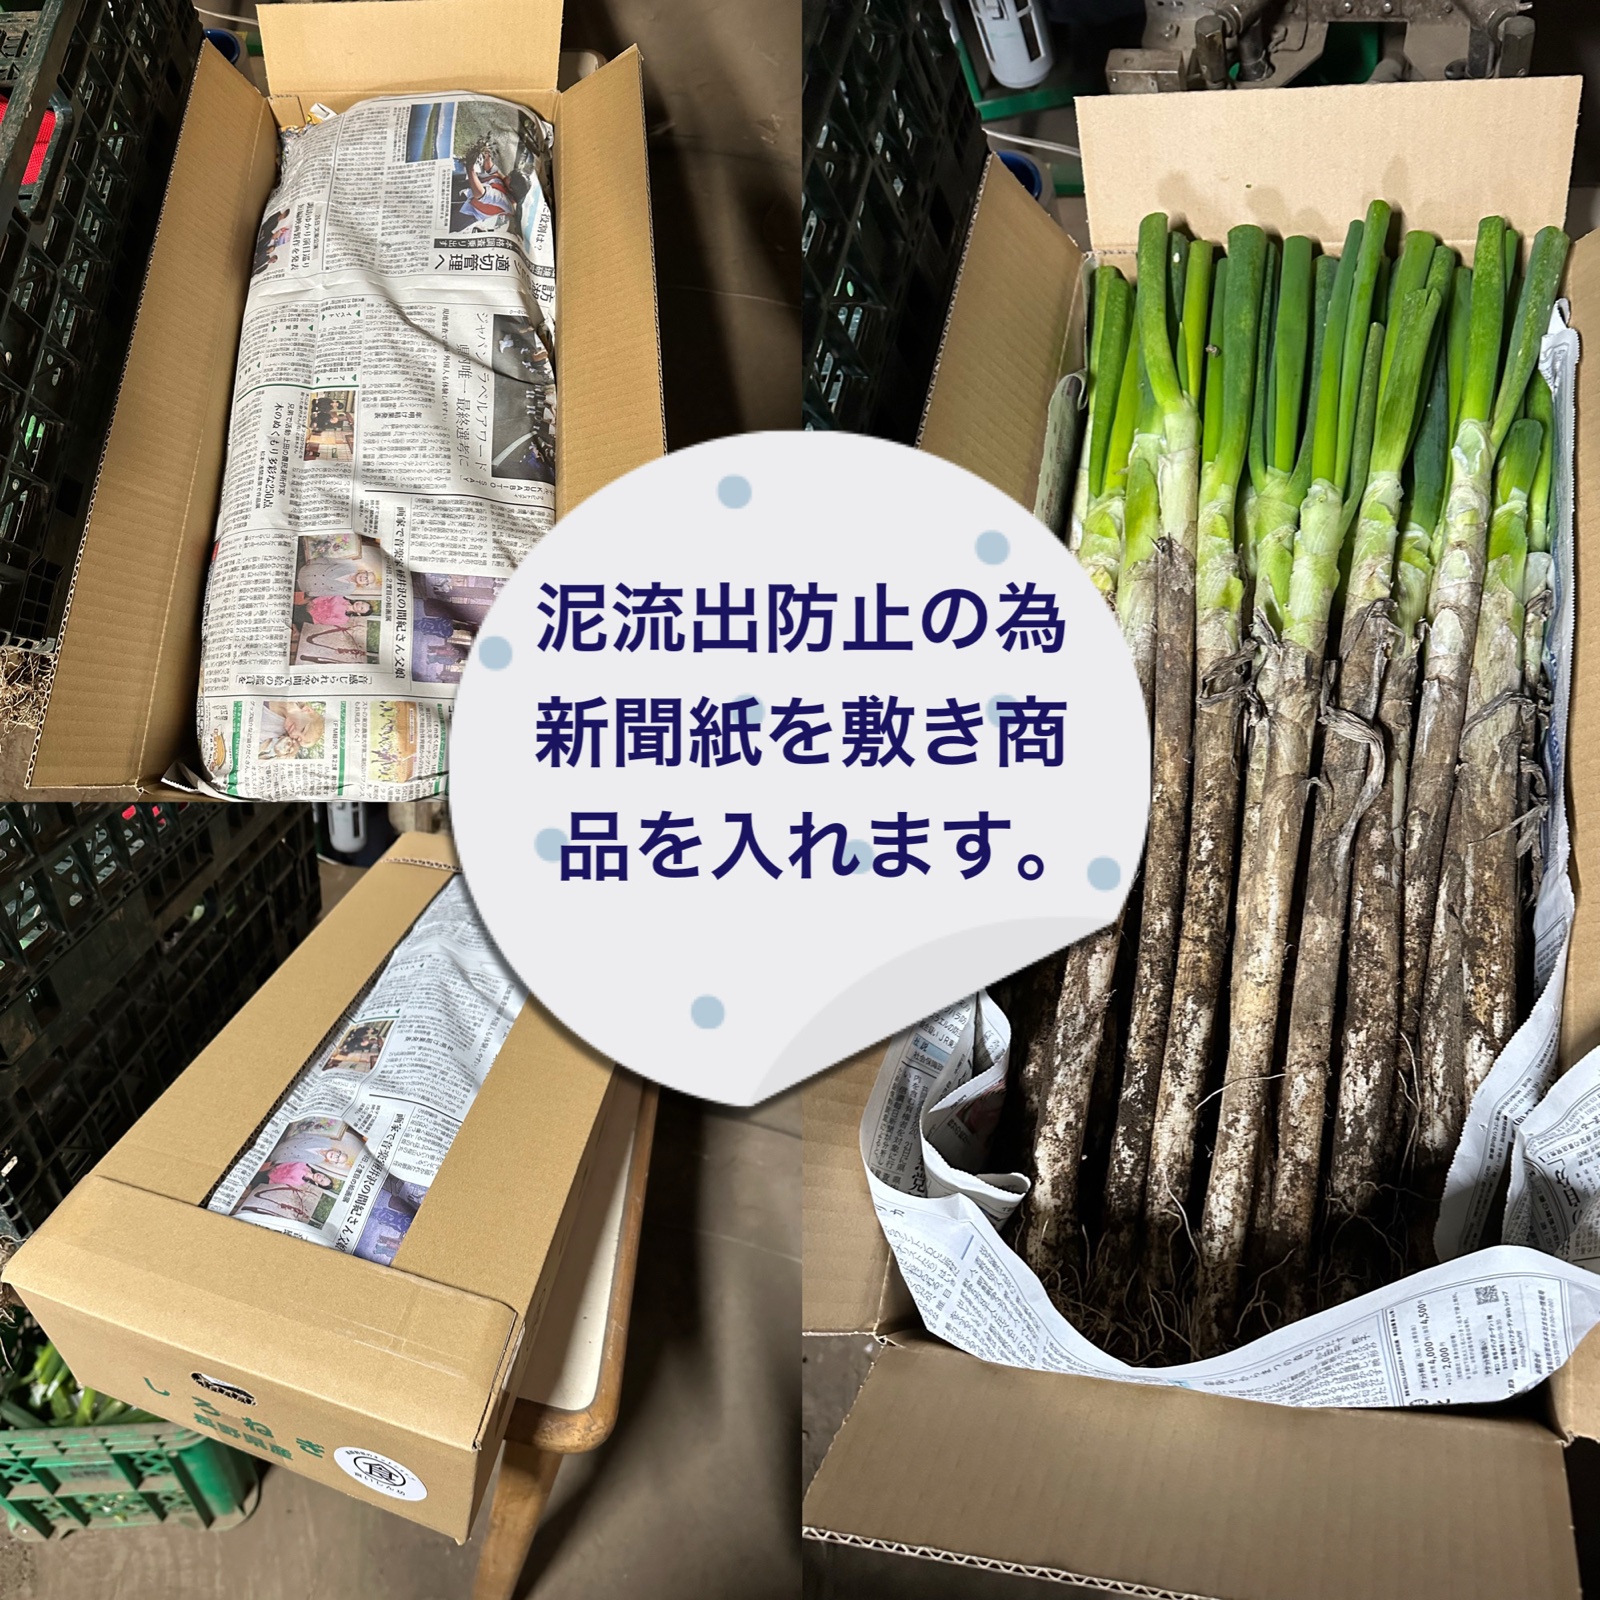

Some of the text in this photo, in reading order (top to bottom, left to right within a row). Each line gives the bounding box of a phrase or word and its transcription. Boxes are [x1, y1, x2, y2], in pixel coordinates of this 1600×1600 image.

[435, 253, 510, 272] 適切管理へ
[476, 312, 489, 472] ジャパンラベルアワード
[278, 403, 294, 495] 兄弟で活動 上田の農民美術作家
[456, 398, 470, 466] 最終選考に
[395, 507, 406, 566] 画家で音楽家
[235, 674, 374, 685] 「音感じられる空間で絵の鑑賞を」
[1417, 1362, 1427, 1387] チケット料金
[143, 1376, 325, 1458] しろねぎ
